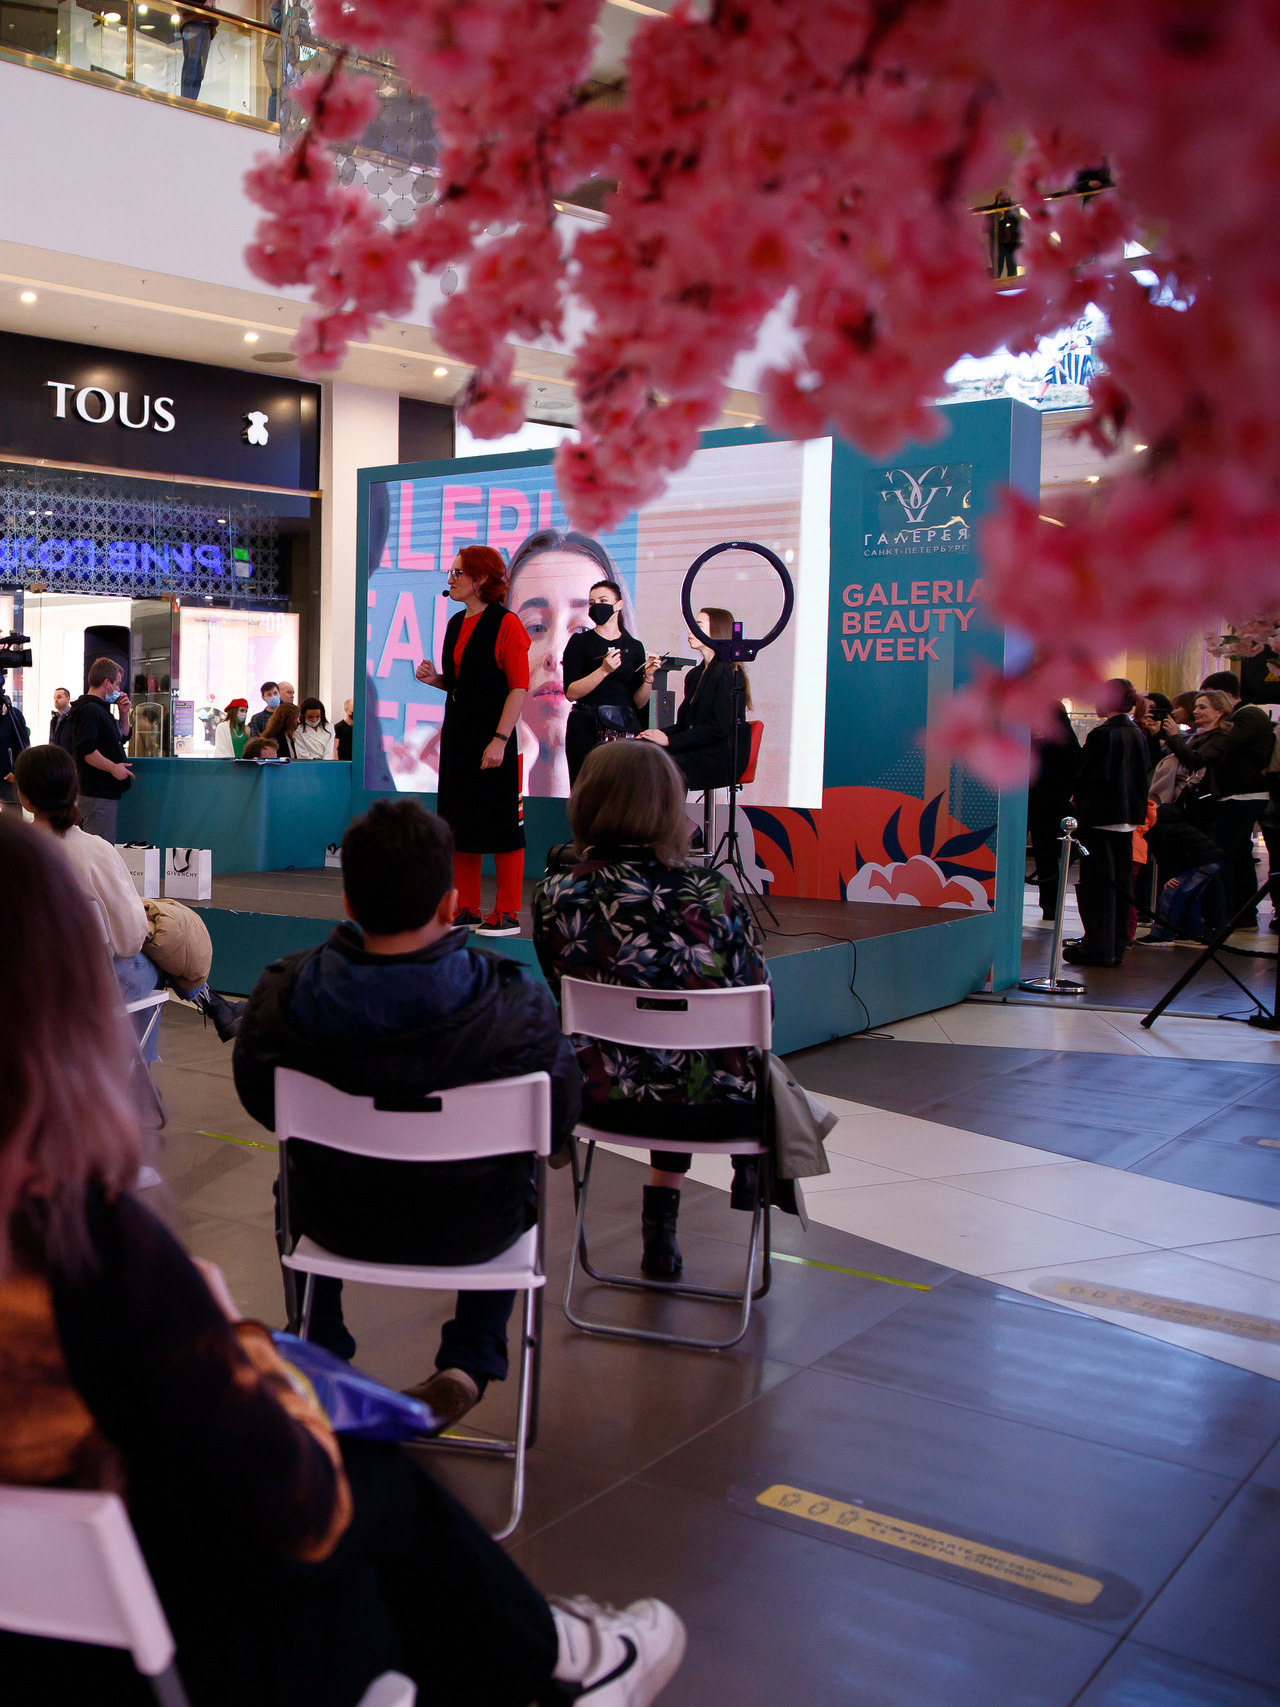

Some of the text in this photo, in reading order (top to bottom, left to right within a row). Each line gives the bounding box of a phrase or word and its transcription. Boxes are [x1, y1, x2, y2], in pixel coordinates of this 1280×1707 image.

[45, 381, 176, 433] TOUS
[376, 482, 598, 572] LERI
[864, 528, 969, 546] ГАЛЕРЕЯ
[863, 544, 969, 557] САНКТ-ПЕТЕРБУРГ
[842, 579, 986, 607] GALERIA
[842, 608, 976, 634] BEAUTY
[840, 637, 940, 662] WEEK
[166, 870, 198, 878] GIVENCHY
